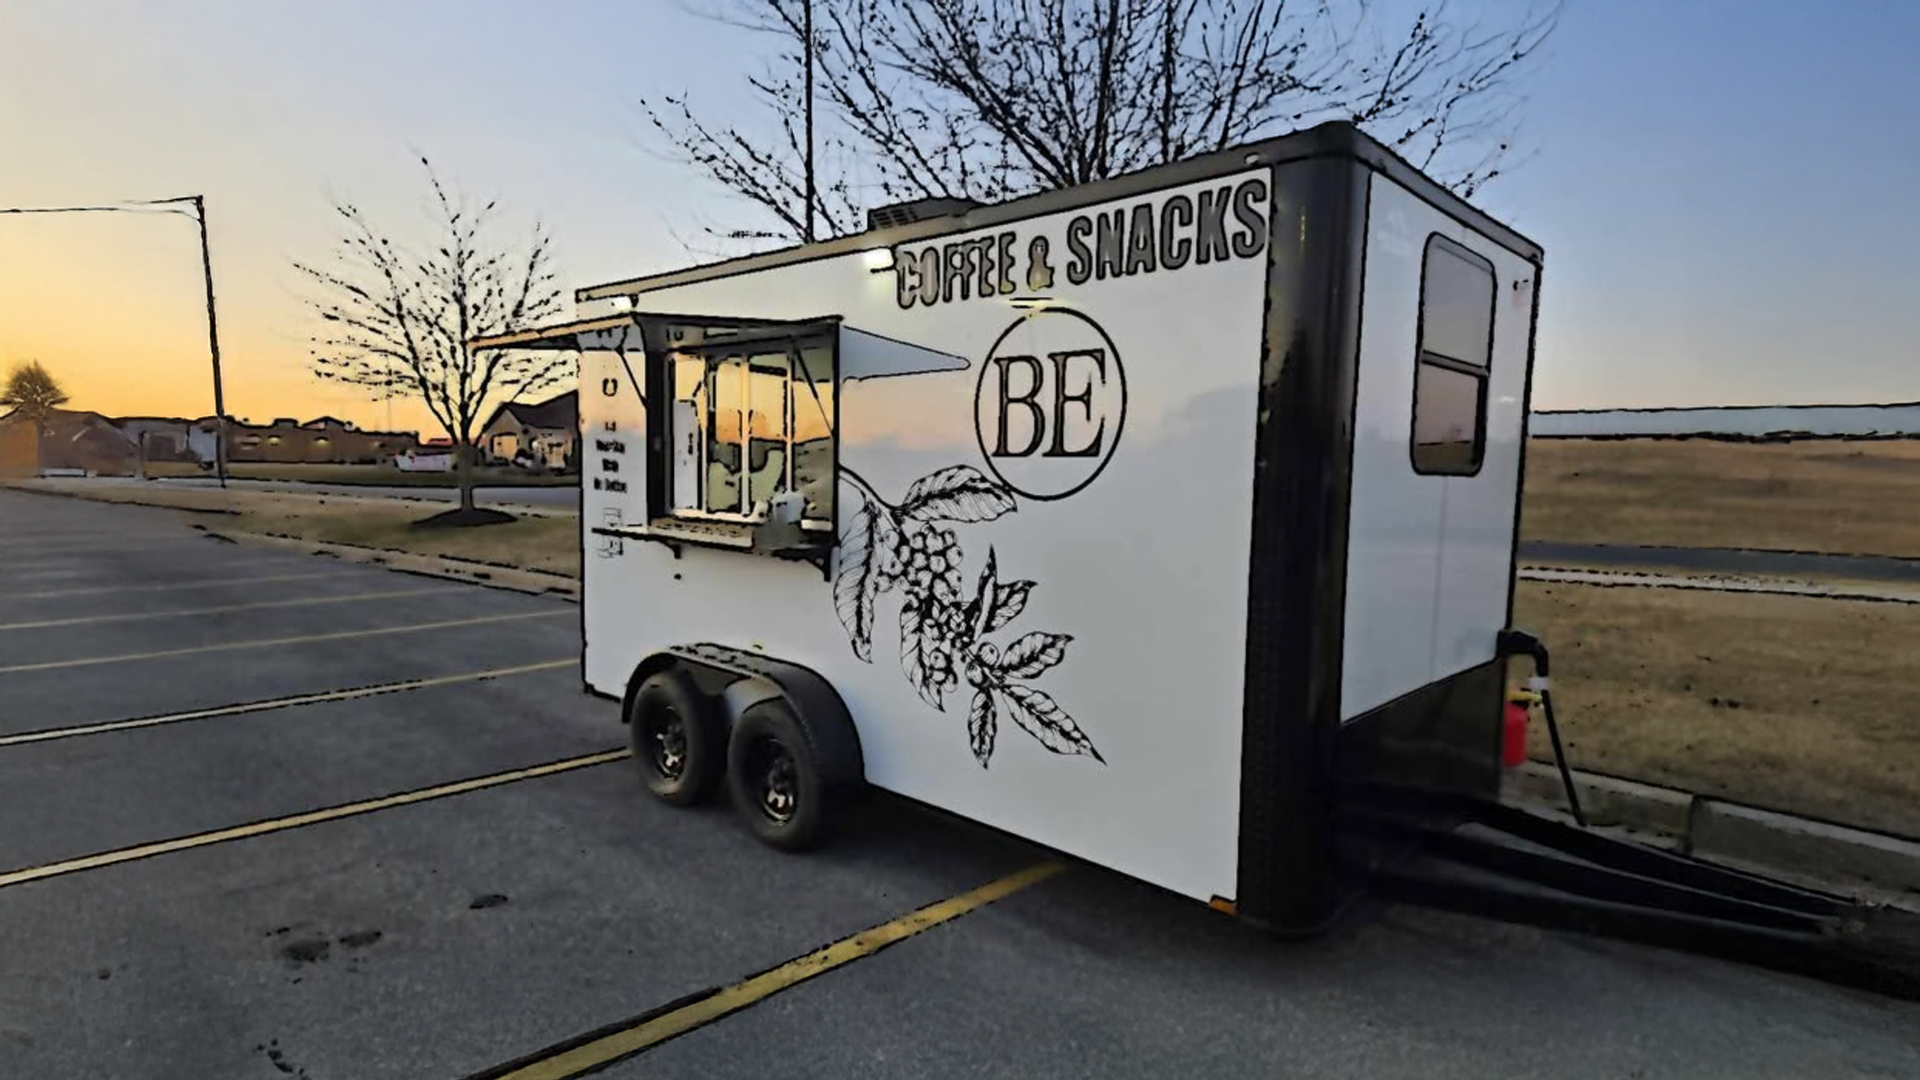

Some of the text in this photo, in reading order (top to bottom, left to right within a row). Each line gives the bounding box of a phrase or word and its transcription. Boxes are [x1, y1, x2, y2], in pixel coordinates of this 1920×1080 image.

[896, 178, 1268, 309] COFFEE & SNACKS
[992, 348, 1106, 458] BE
